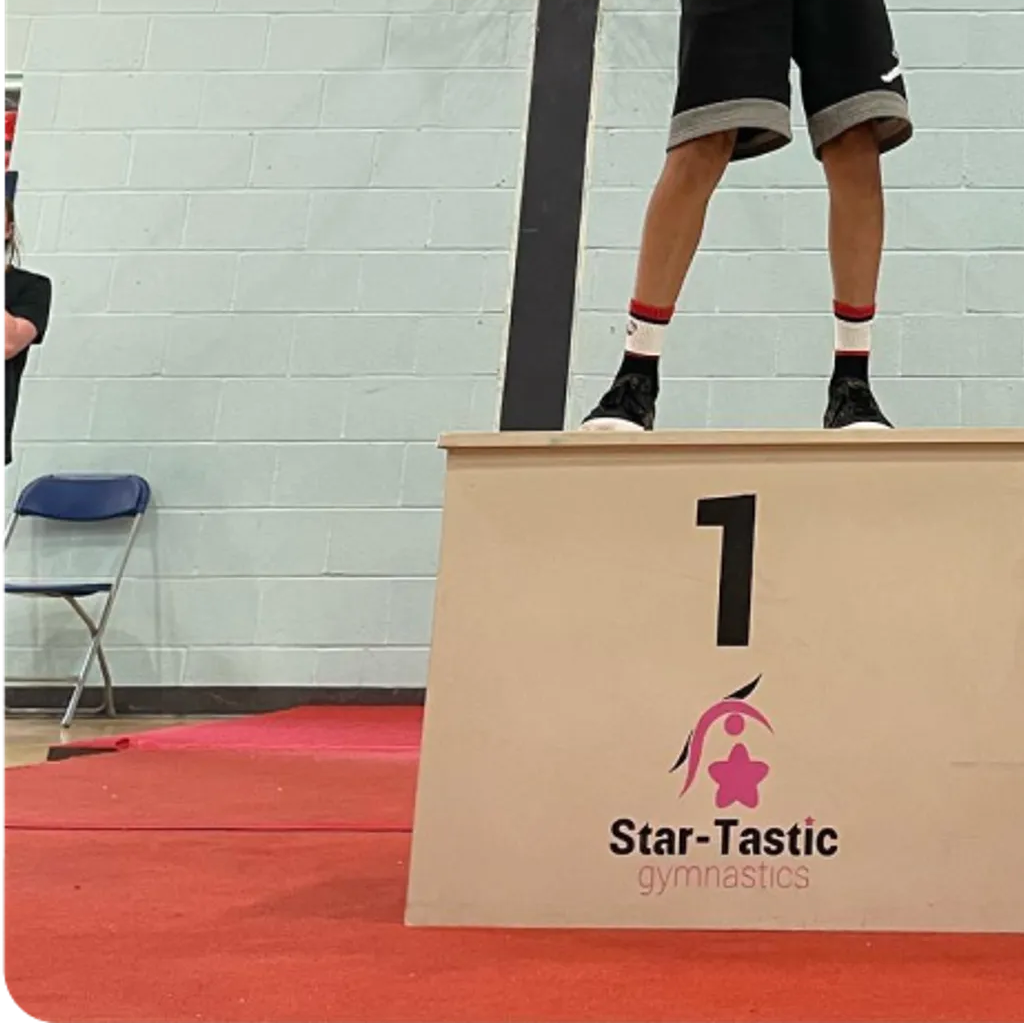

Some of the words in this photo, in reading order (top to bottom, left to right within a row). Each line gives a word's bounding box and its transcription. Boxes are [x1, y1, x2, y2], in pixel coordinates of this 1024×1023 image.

[696, 494, 757, 647] 1
[609, 816, 839, 857] Star-Tastic
[638, 860, 810, 896] gymnastics
